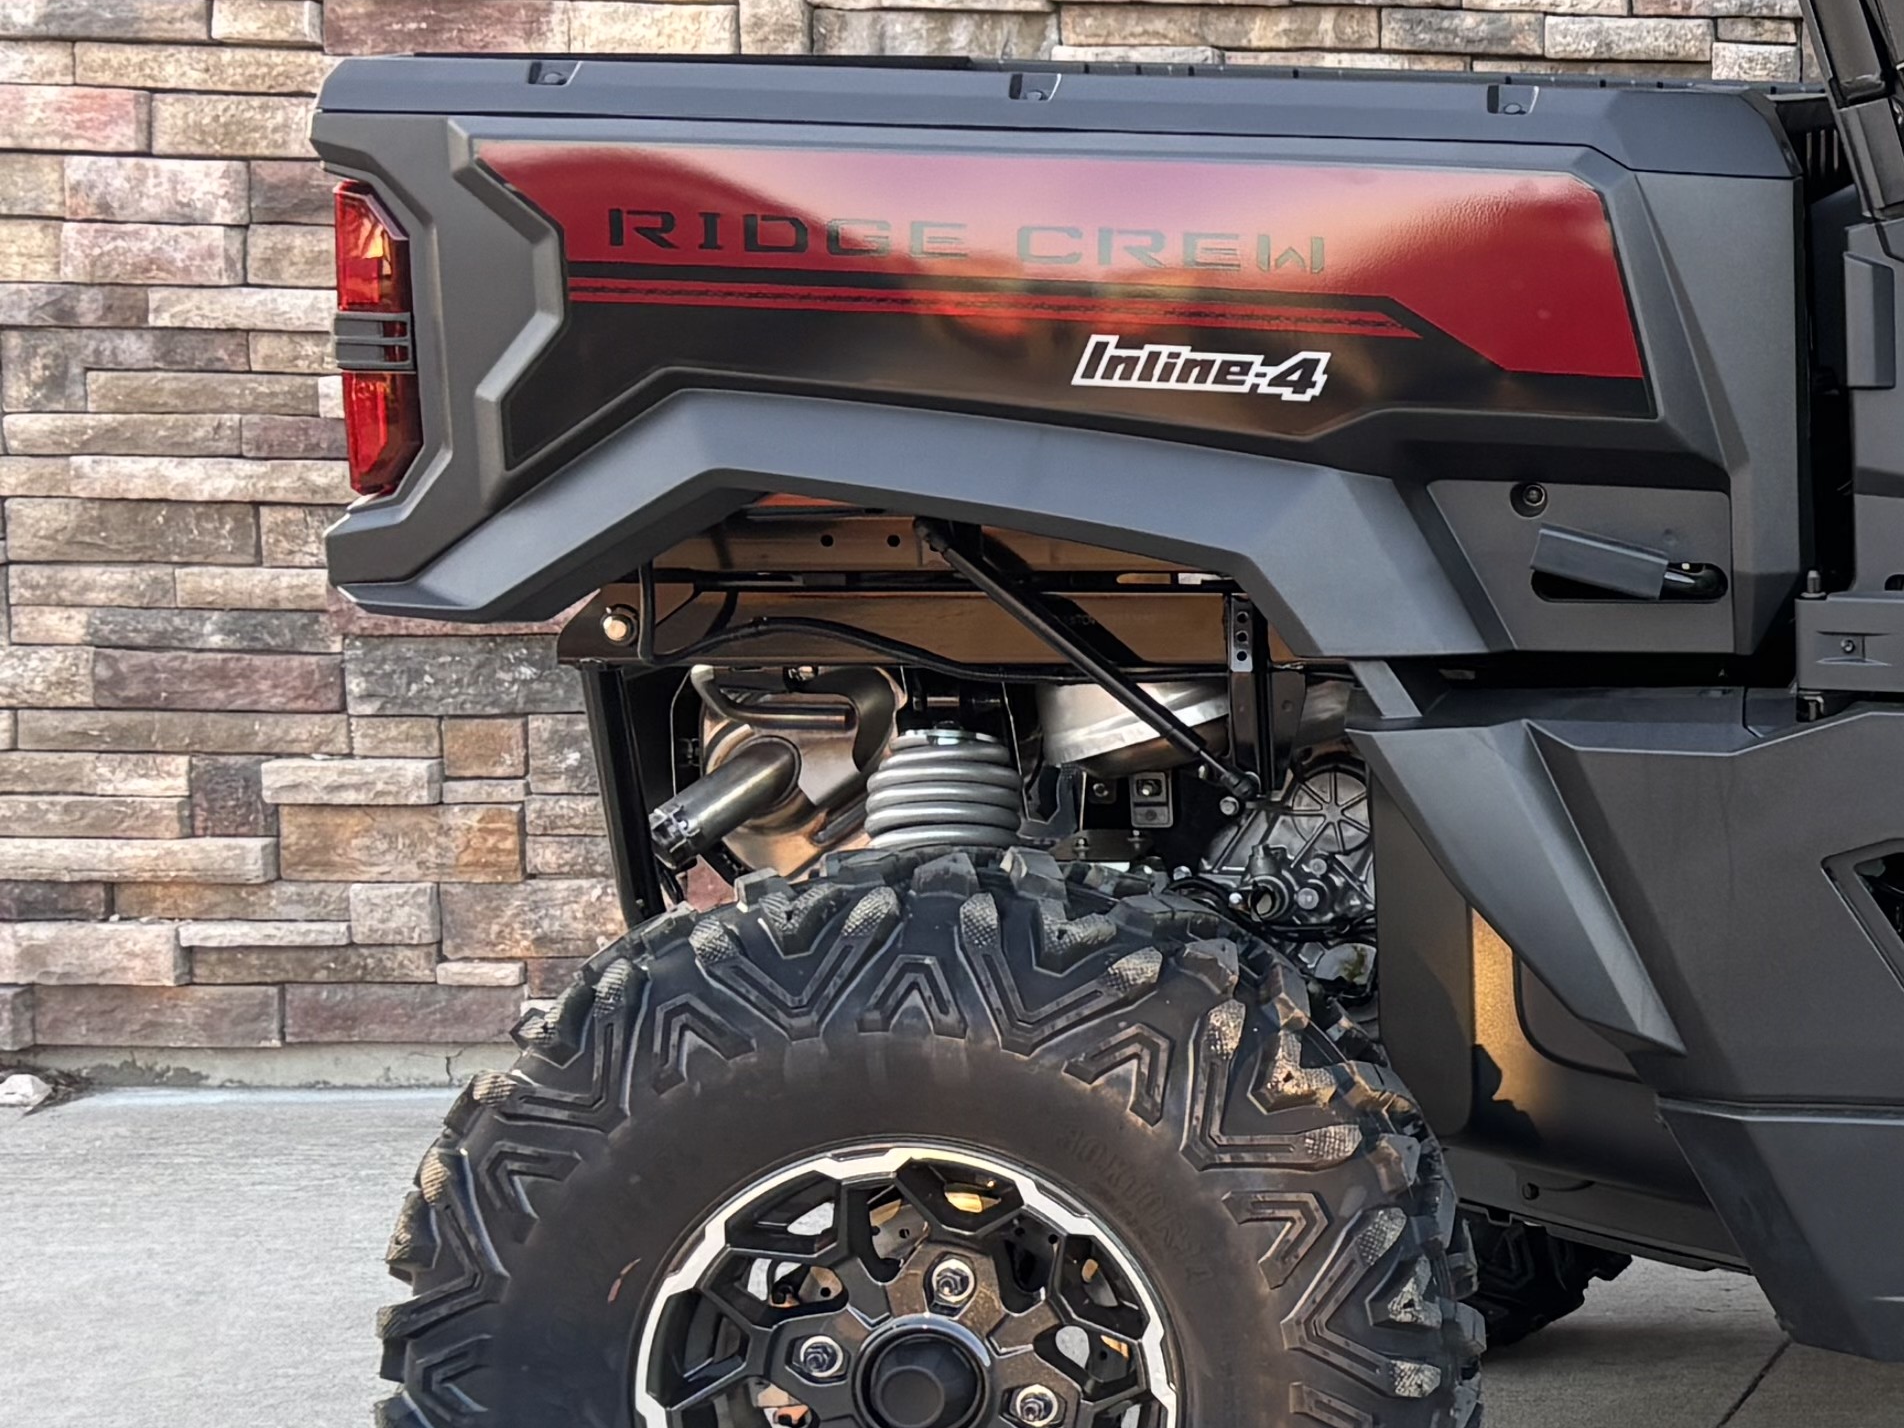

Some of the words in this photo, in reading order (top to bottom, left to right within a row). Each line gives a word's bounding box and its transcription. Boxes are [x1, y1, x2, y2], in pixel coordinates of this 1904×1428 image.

[608, 207, 968, 259] RIDGE
[1017, 225, 1325, 273] CREW
[1072, 334, 1331, 401] Inline-4
